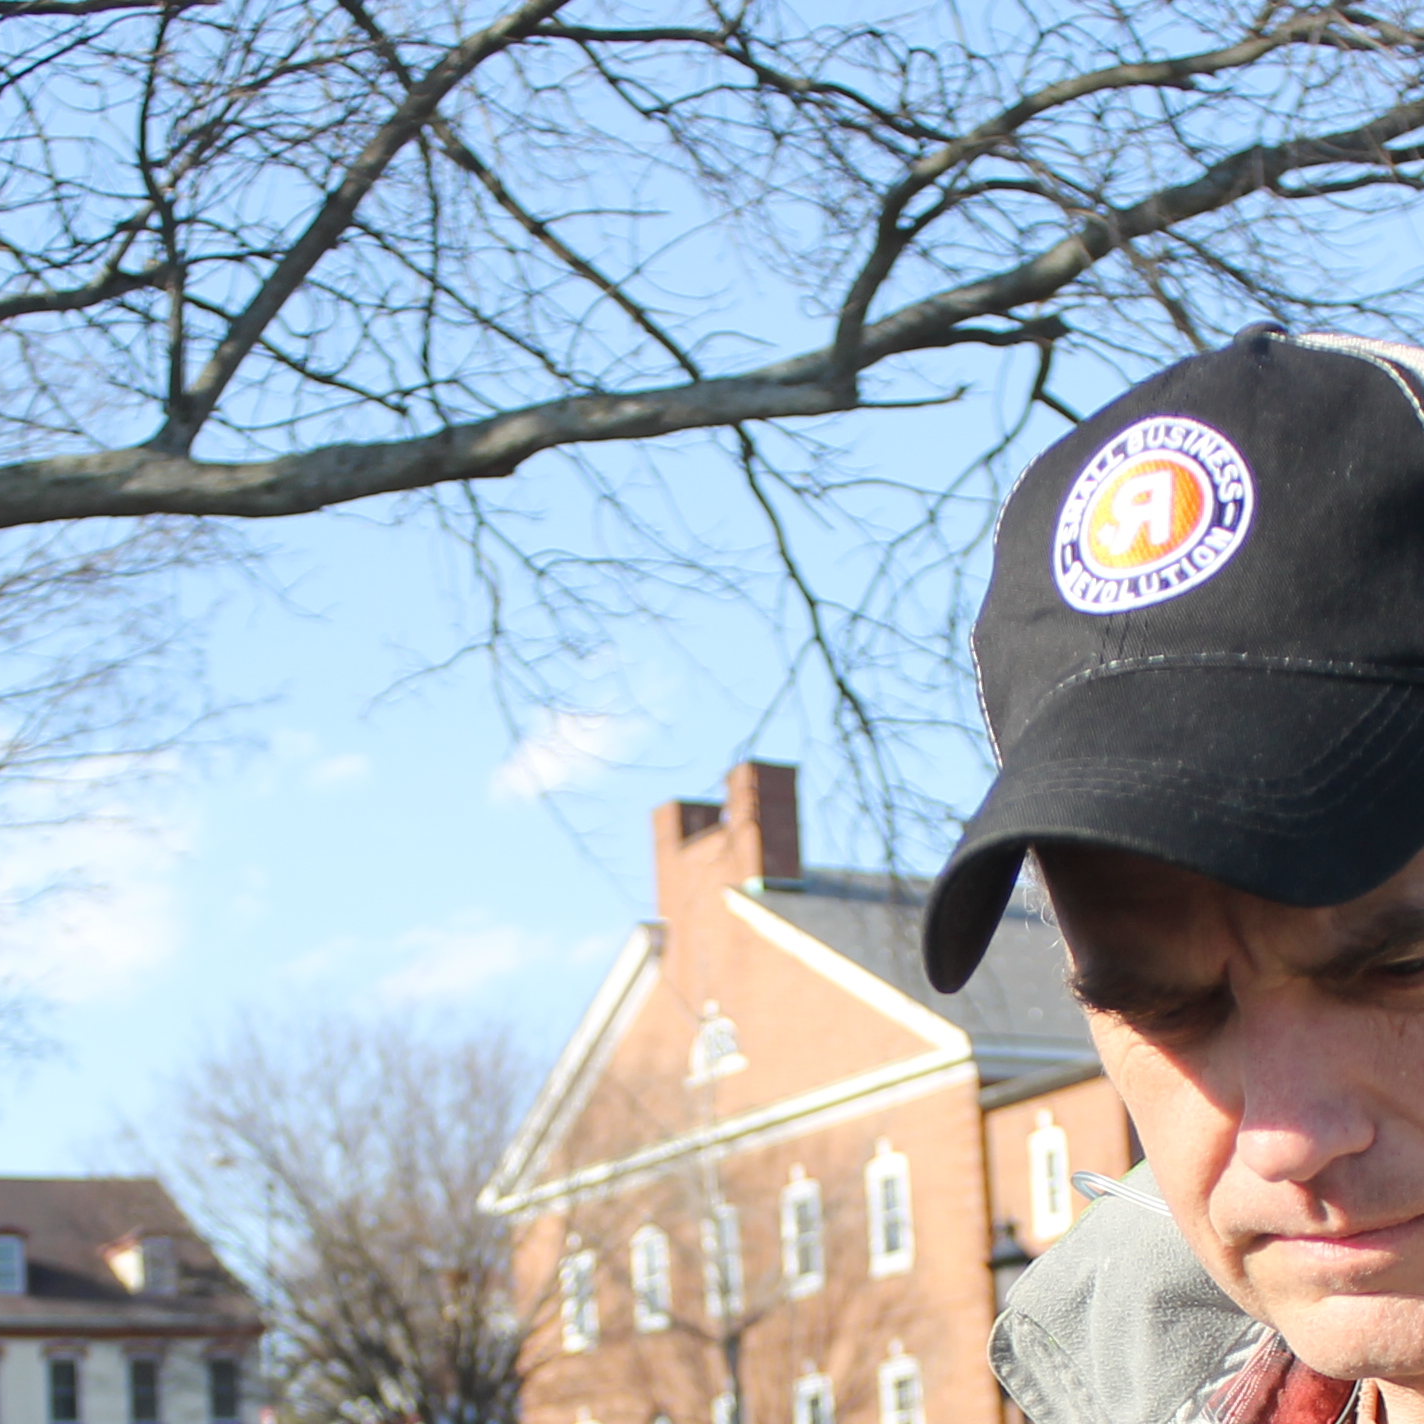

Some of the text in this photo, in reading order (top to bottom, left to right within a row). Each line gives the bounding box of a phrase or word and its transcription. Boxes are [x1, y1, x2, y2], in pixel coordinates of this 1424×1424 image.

[1062, 423, 1243, 542] SMALL BUSINESS
[1063, 525, 1234, 603] REVOLUTION
